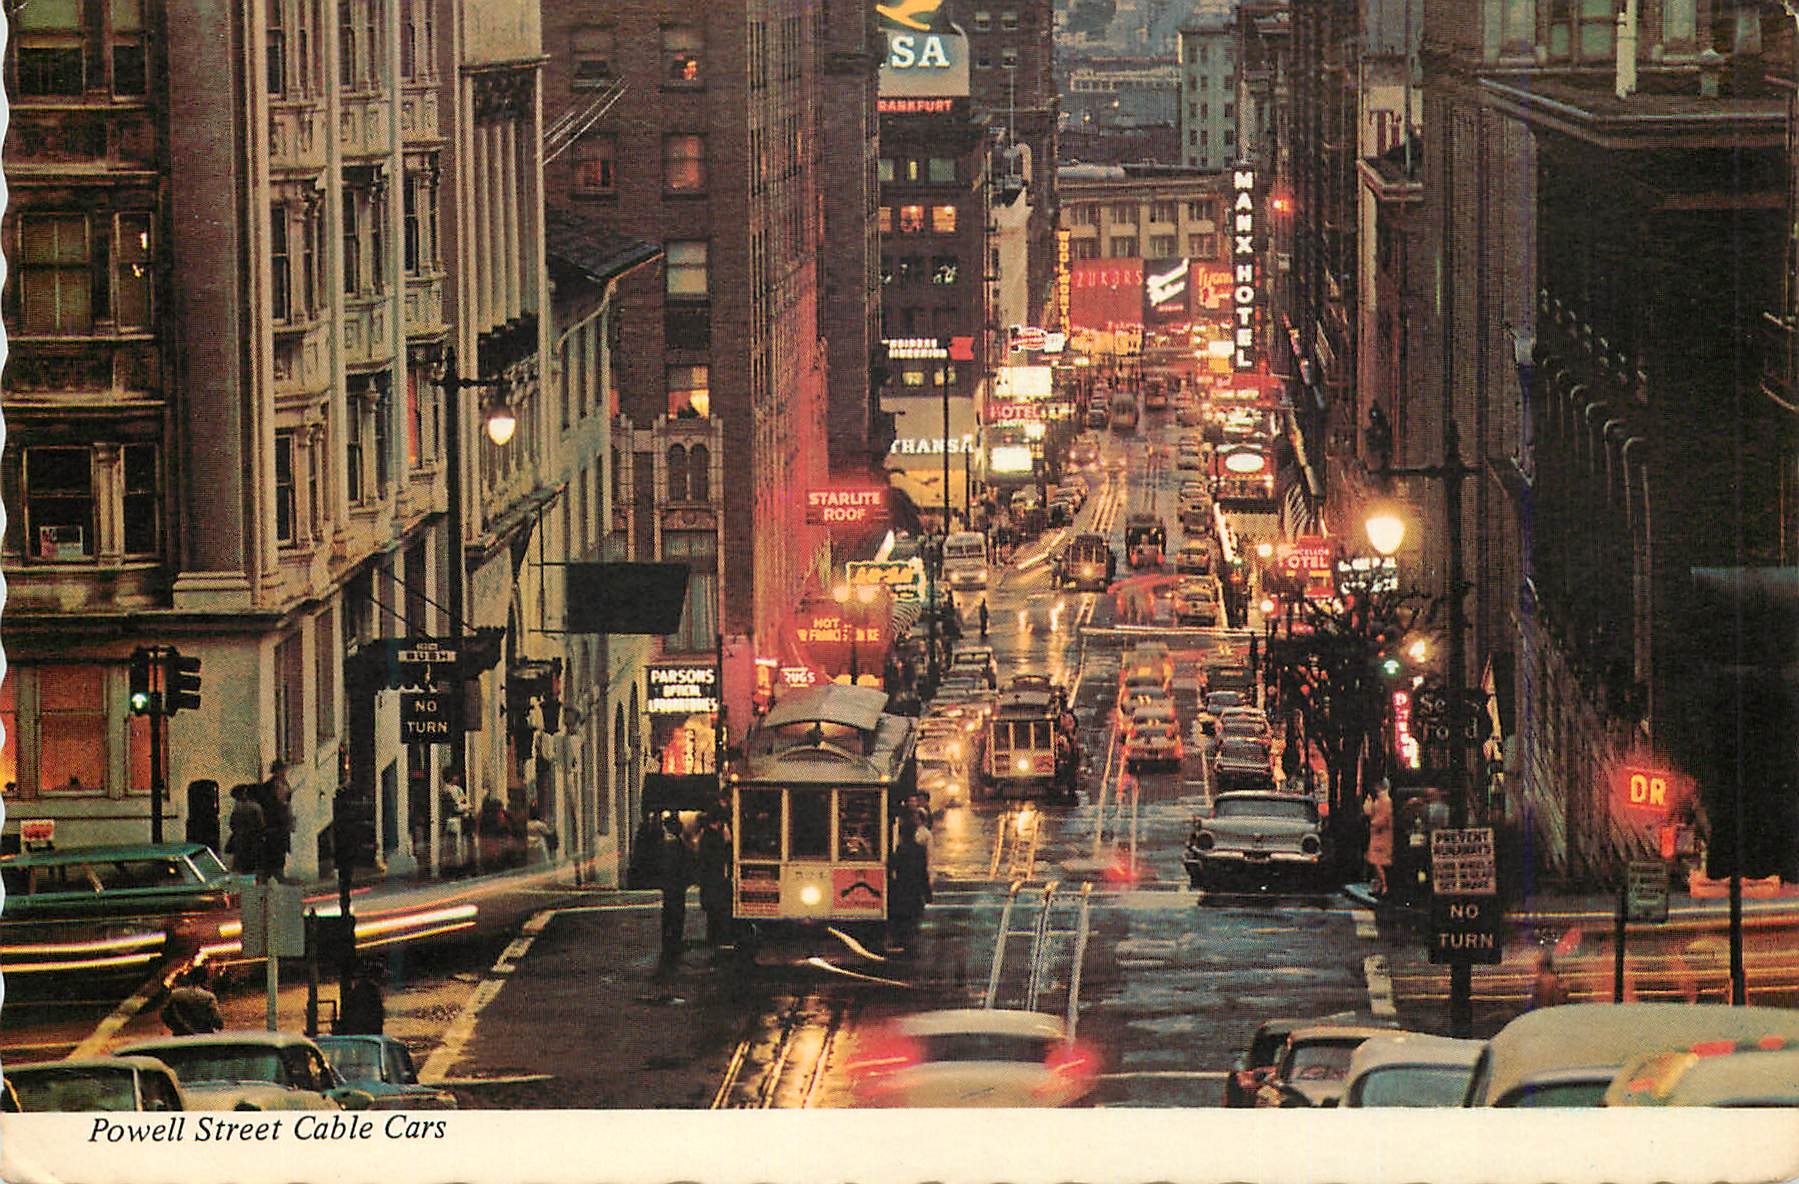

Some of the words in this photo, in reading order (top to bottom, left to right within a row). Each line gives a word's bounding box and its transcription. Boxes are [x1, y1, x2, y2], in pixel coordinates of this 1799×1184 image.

[1235, 264, 1255, 367] HOTEL
[808, 492, 880, 505] STARLITE
[823, 508, 866, 521] ROOF
[651, 669, 715, 684] PARSONS
[415, 700, 437, 712] NO
[407, 721, 449, 733] TURN
[1630, 775, 1666, 805] DR
[1450, 904, 1478, 918] NO
[1440, 933, 1494, 948] TURN
